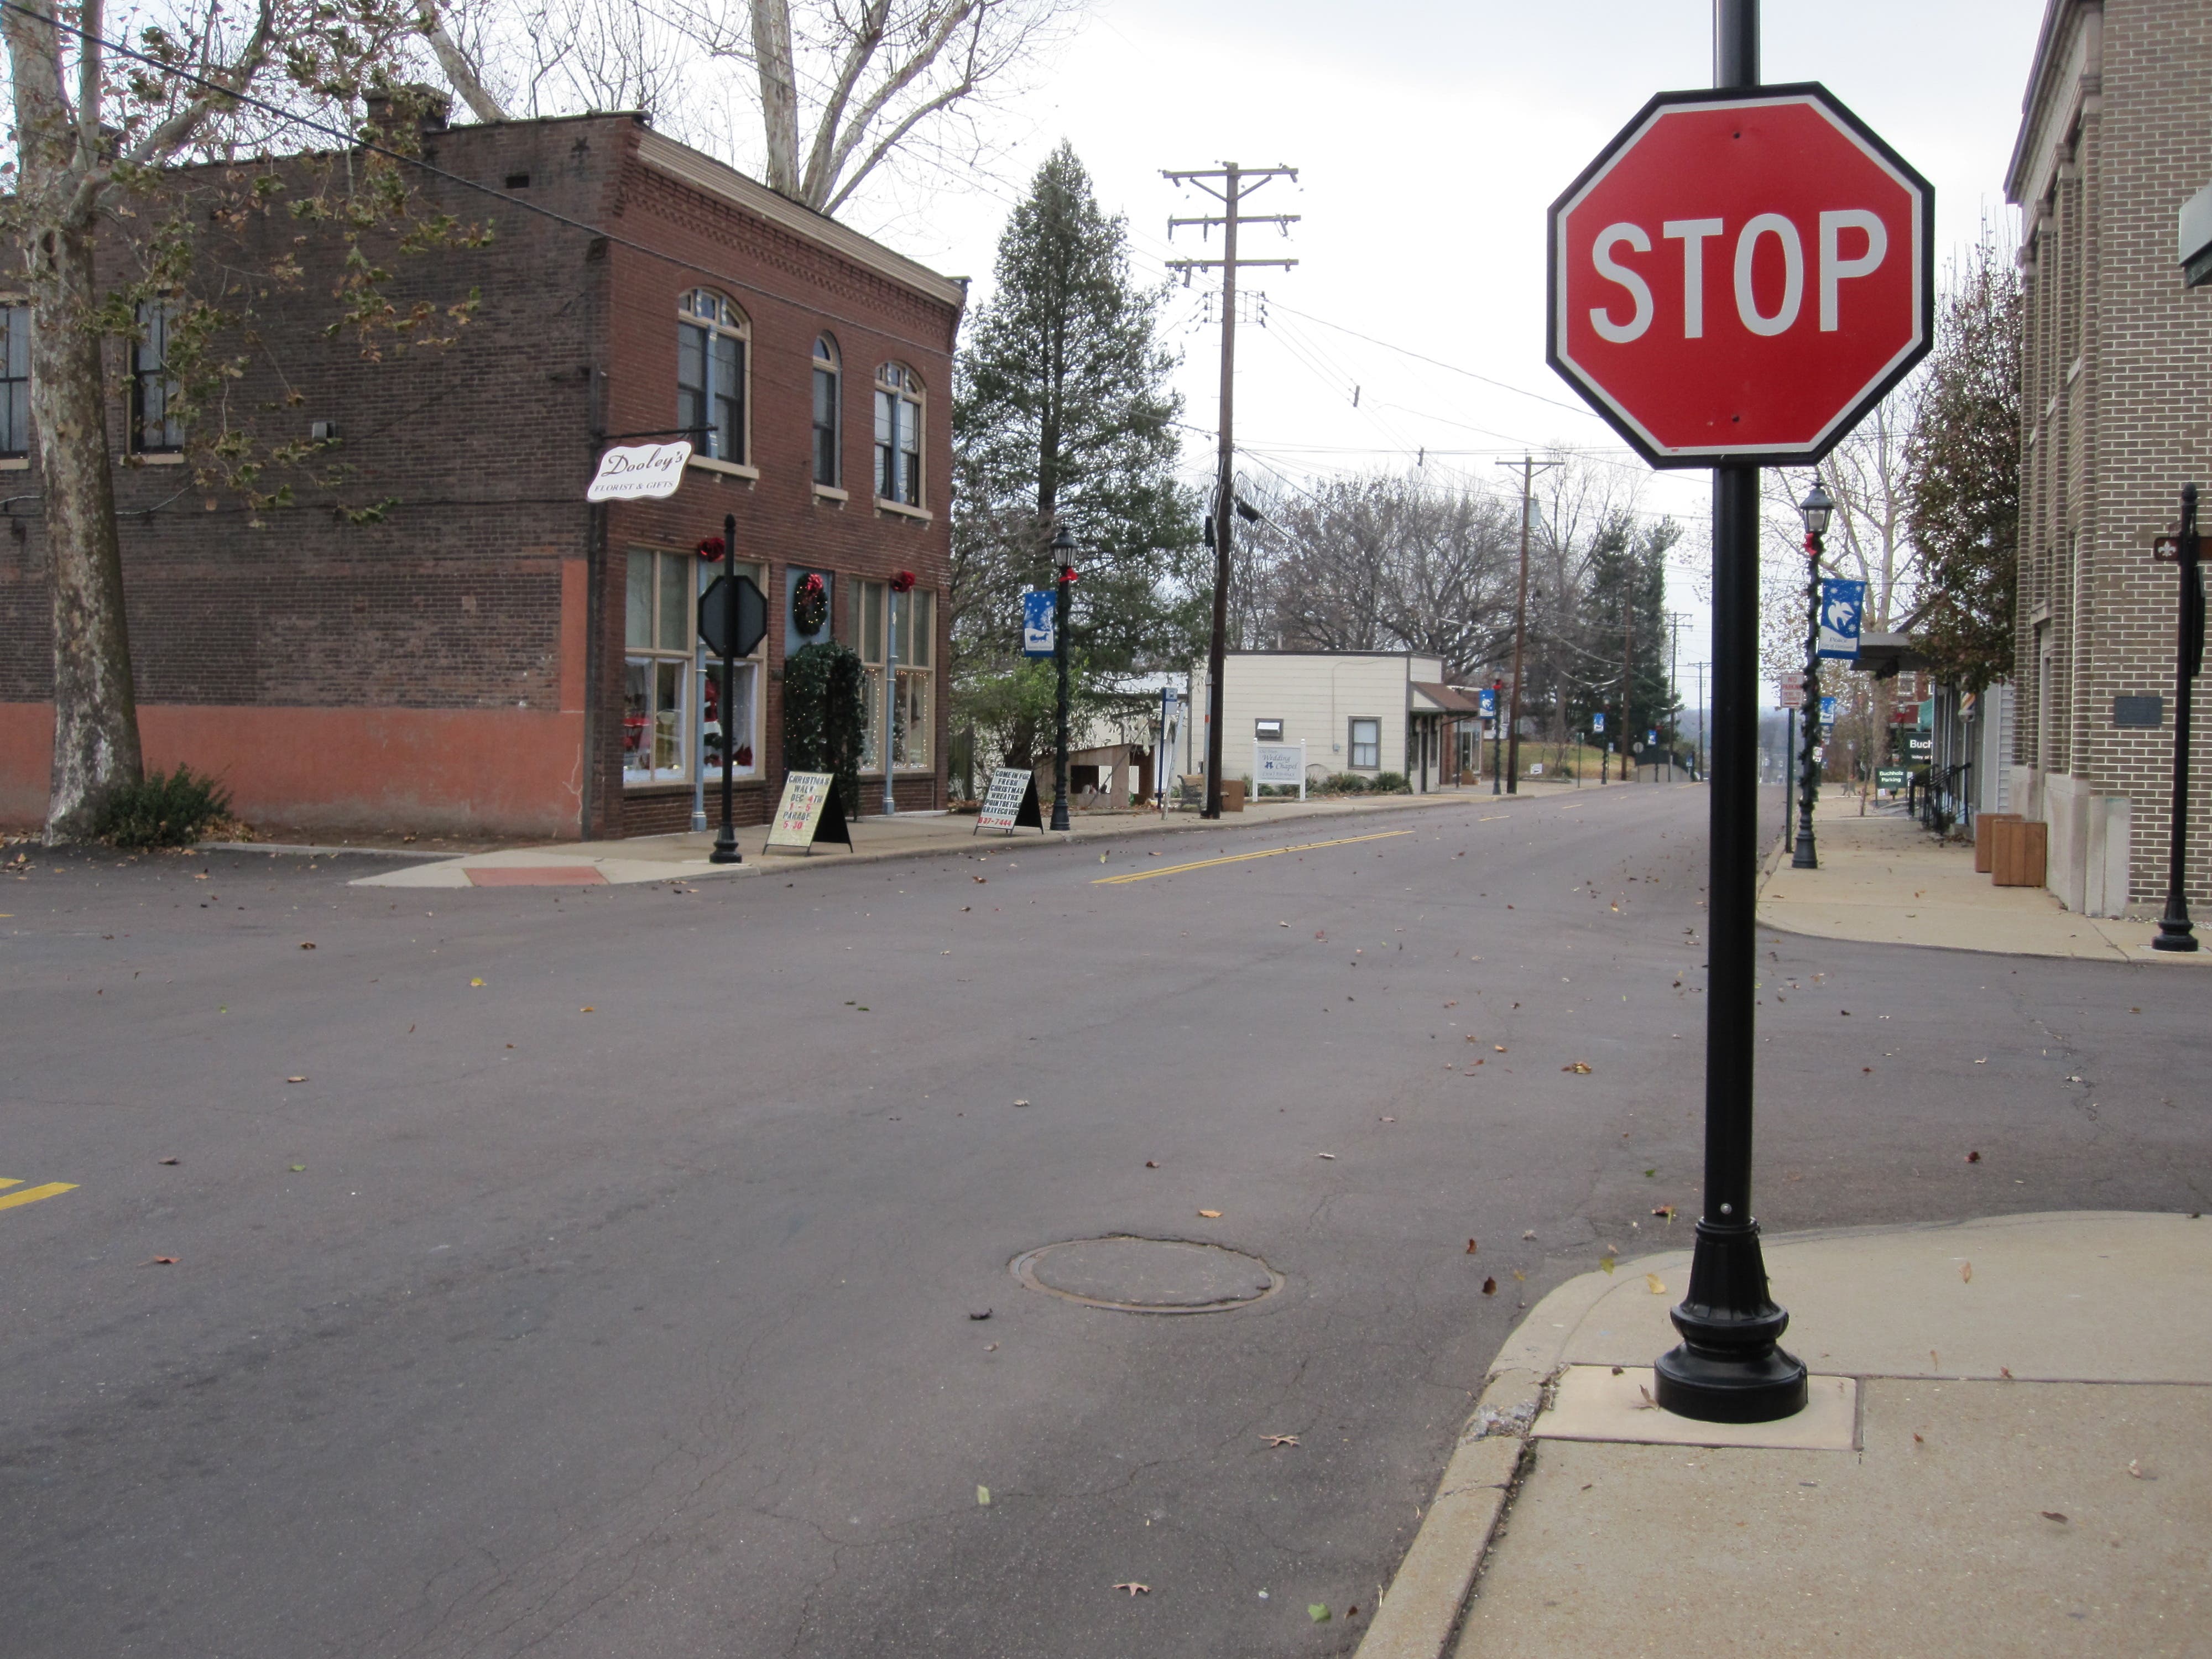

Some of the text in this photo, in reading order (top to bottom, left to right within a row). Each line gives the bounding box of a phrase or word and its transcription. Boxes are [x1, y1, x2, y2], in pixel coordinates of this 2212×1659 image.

[1589, 208, 1887, 343] STOP
[601, 447, 684, 477] Dooley's
[594, 483, 634, 492] FLORIST
[646, 481, 674, 489] GIFTS
[1262, 754, 1291, 764] Wedding
[1275, 763, 1298, 771] Chapel
[995, 770, 1011, 779] COME
[789, 775, 830, 785] CHRISTMAS
[998, 778, 1018, 786] FRESH
[794, 785, 814, 794] WALK
[990, 785, 1025, 795] CHRISTMAS
[791, 794, 804, 802] DEC
[991, 792, 1019, 801] WREATHS
[783, 812, 811, 821] PARADE
